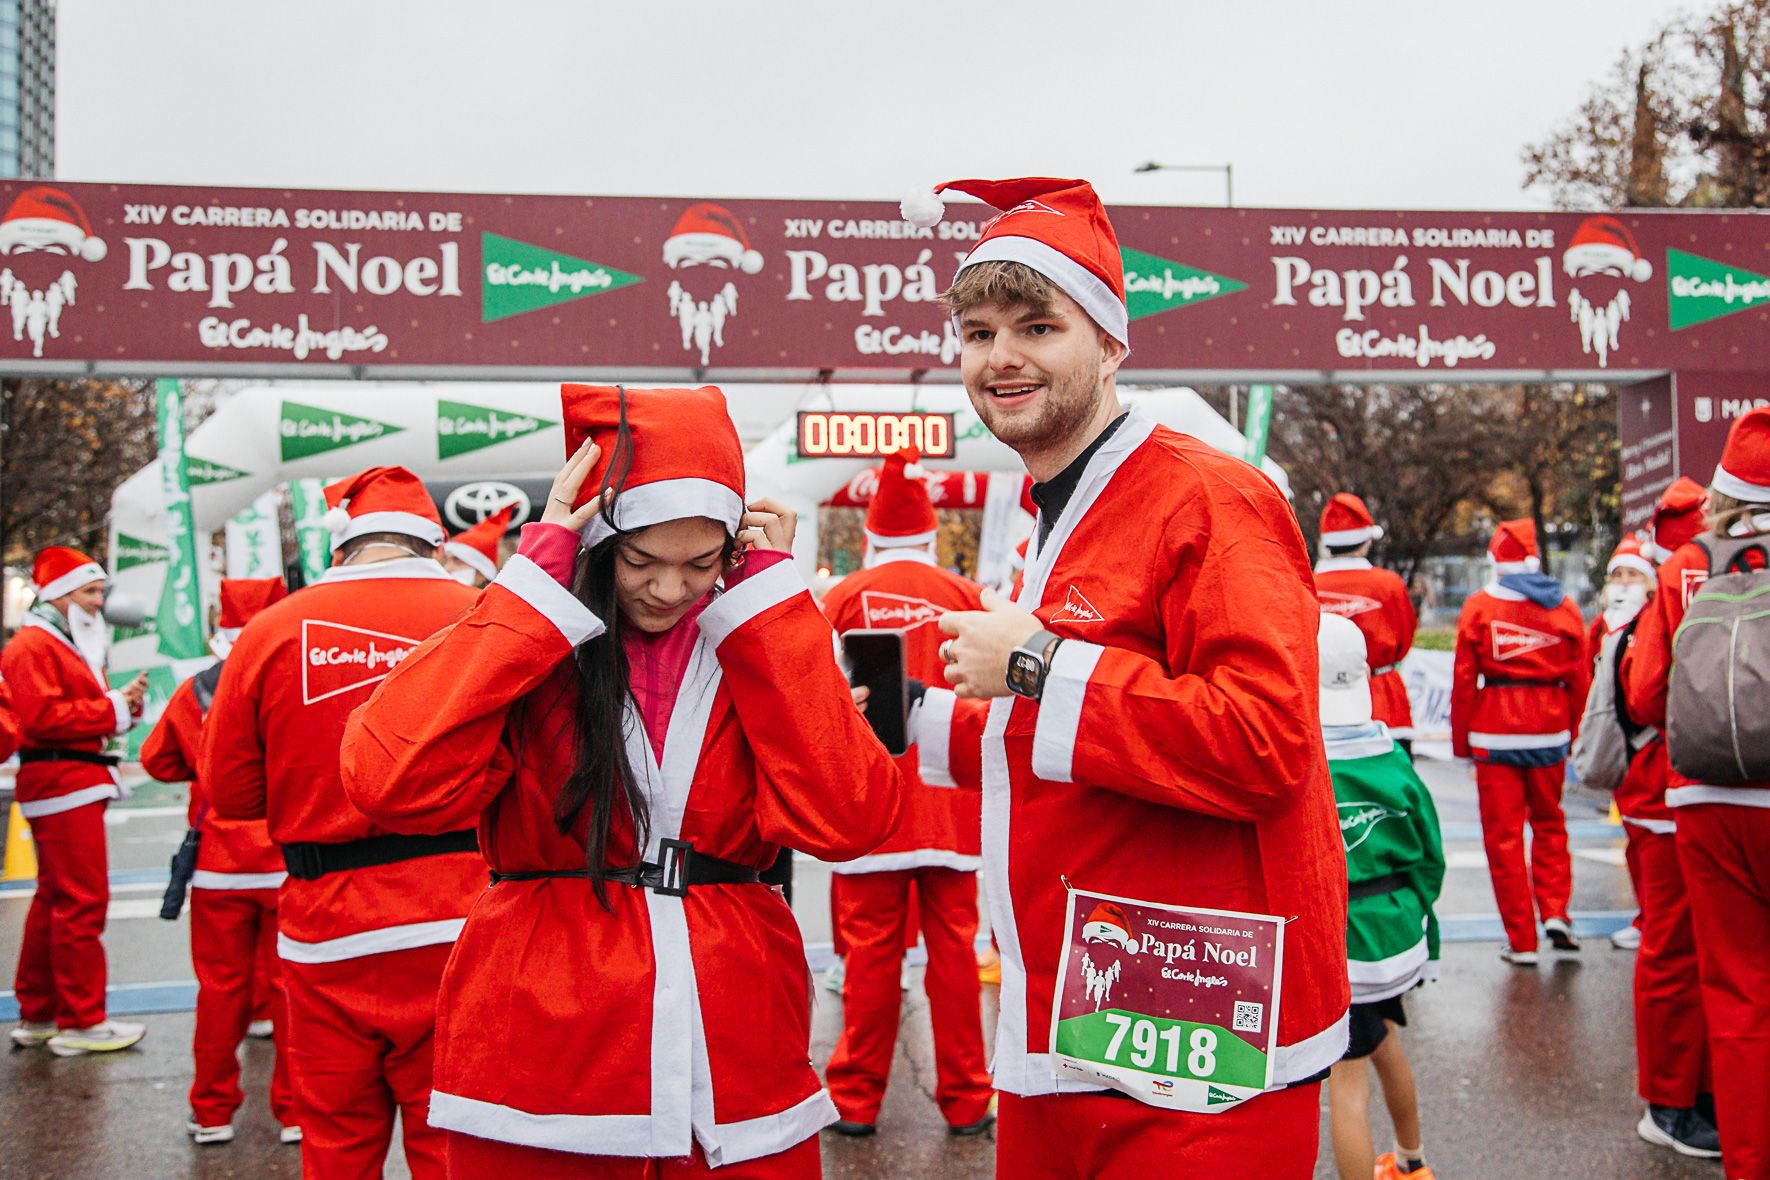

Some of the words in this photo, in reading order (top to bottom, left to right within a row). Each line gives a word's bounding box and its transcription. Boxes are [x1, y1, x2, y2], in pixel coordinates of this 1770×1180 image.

[123, 204, 167, 225] XIV
[171, 205, 290, 228] CARRERA
[294, 208, 424, 231] SOLIDARIA
[429, 212, 463, 232] DE
[784, 219, 823, 238] XIV
[827, 219, 934, 240] CARRERA
[1270, 225, 1307, 245] XIV
[1310, 226, 1410, 247] CARRERA
[1412, 227, 1522, 248] SOLIDARIA
[1525, 229, 1555, 249] DE
[122, 237, 296, 309] Papá
[311, 241, 463, 296] Noel
[785, 249, 938, 316] Papá
[1270, 255, 1416, 321] Papá
[1427, 256, 1557, 308] Noel
[1147, 919, 1160, 927] XIV
[1160, 921, 1197, 932] CARRERA
[1199, 925, 1240, 937] SOLIDARIA
[1242, 930, 1253, 938] DE
[1140, 933, 1196, 964] Papá
[1202, 941, 1257, 968] Noel
[1161, 967, 1172, 978] El
[1172, 969, 1194, 982] Corte
[1193, 969, 1228, 987] Inglés
[1104, 1013, 1218, 1078] 7918
